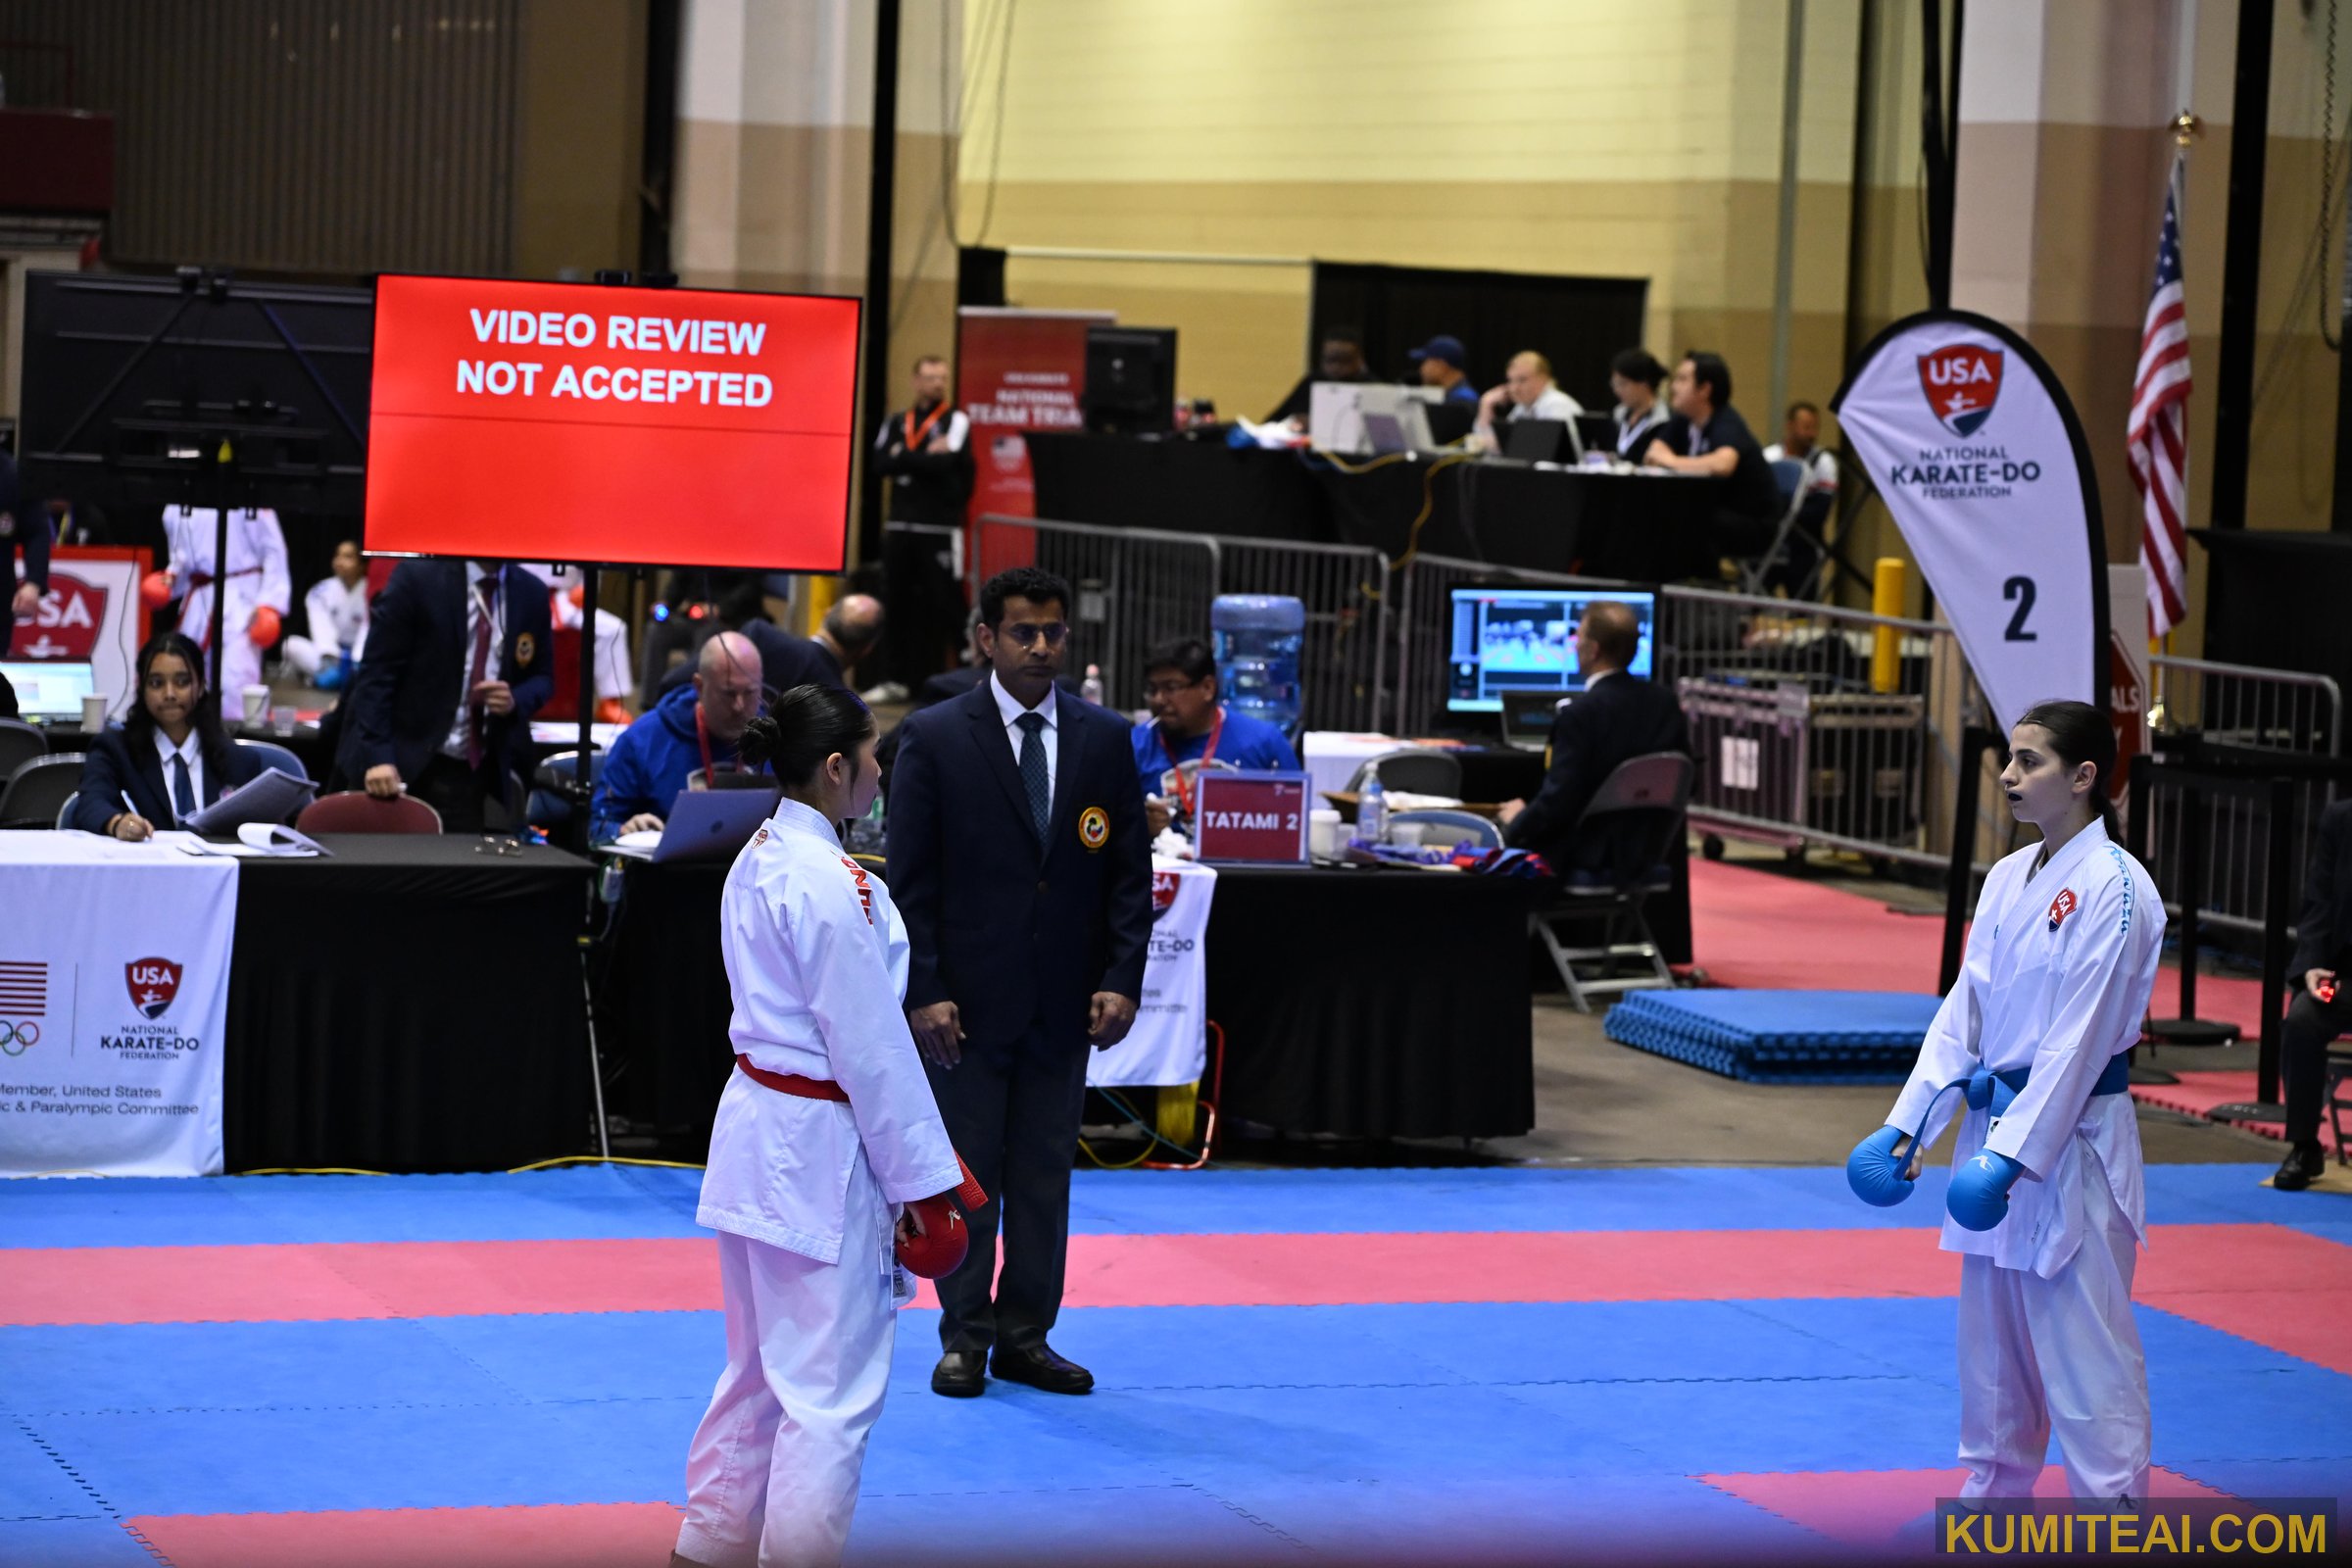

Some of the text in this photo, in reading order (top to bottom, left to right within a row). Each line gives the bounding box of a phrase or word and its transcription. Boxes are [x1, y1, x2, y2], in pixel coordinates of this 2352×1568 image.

[469, 308, 767, 357] VIDEO REVIEW
[1929, 357, 1992, 386] USA
[457, 359, 773, 408] NOT ACCEPTED
[967, 403, 1083, 428] TEAM TRIA
[1919, 446, 2008, 462] NATIONAL
[1890, 461, 2041, 485] KARATE-DO
[1922, 485, 2012, 500] FEDERATION
[16, 590, 94, 628] SA
[2002, 575, 2037, 642] 2
[1203, 810, 1299, 831] TATAMI 2
[1152, 873, 1174, 893] SA
[2057, 891, 2072, 916] USA
[1150, 940, 1196, 954] TE-DO
[132, 966, 174, 986] USA
[121, 1025, 179, 1036] NATIONAL
[100, 1035, 200, 1052] KARATE-DO
[120, 1052, 179, 1060] FEDERATION
[62, 1084, 111, 1099] United
[115, 1086, 162, 1099] States
[15, 1102, 25, 1113] &
[30, 1100, 113, 1116] Paralympic
[118, 1103, 199, 1116] Committee
